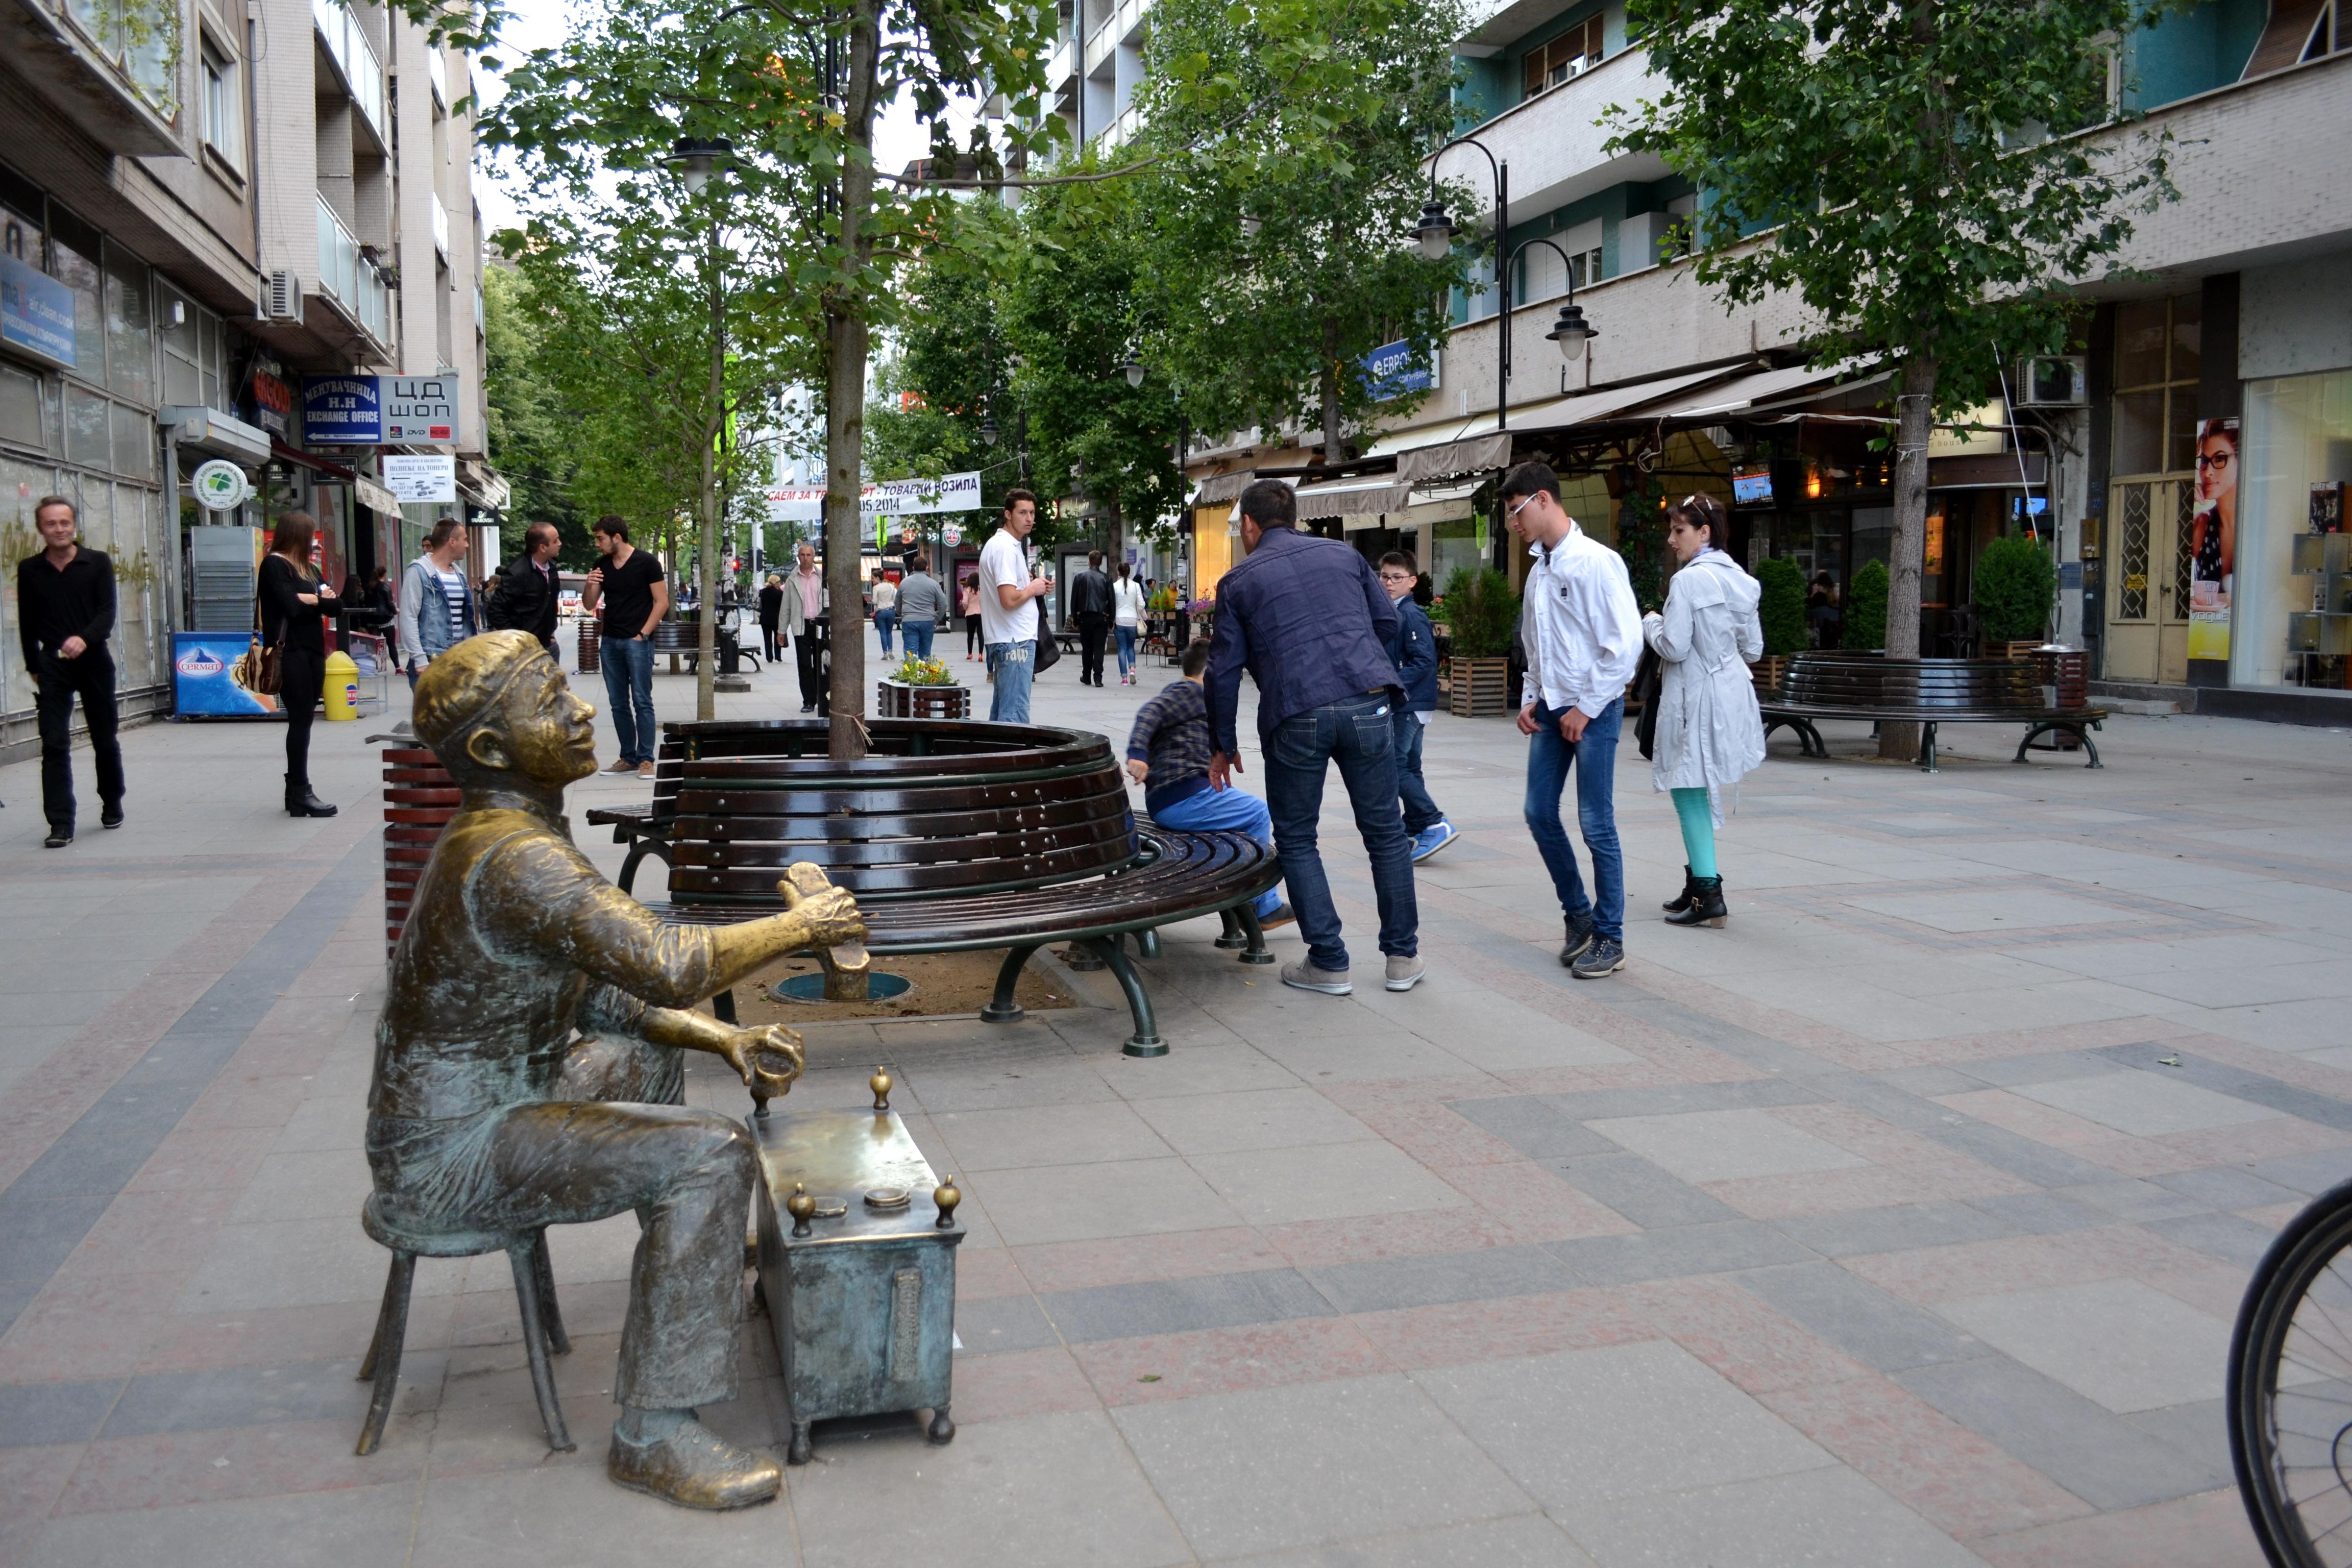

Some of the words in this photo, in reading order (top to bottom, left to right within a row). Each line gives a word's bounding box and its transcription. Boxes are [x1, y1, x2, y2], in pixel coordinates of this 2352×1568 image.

[305, 380, 377, 404] МЕНУВАЧНИЦА
[395, 381, 446, 401] ЦД
[307, 411, 349, 422] EXCHANGE
[351, 410, 379, 423] OFFICE
[389, 405, 450, 417] ШОП
[768, 491, 797, 501] САЕМ
[798, 490, 811, 500] ЗА
[884, 482, 931, 496] ТОВАРНИ
[934, 478, 978, 492] ВОЗИЛА
